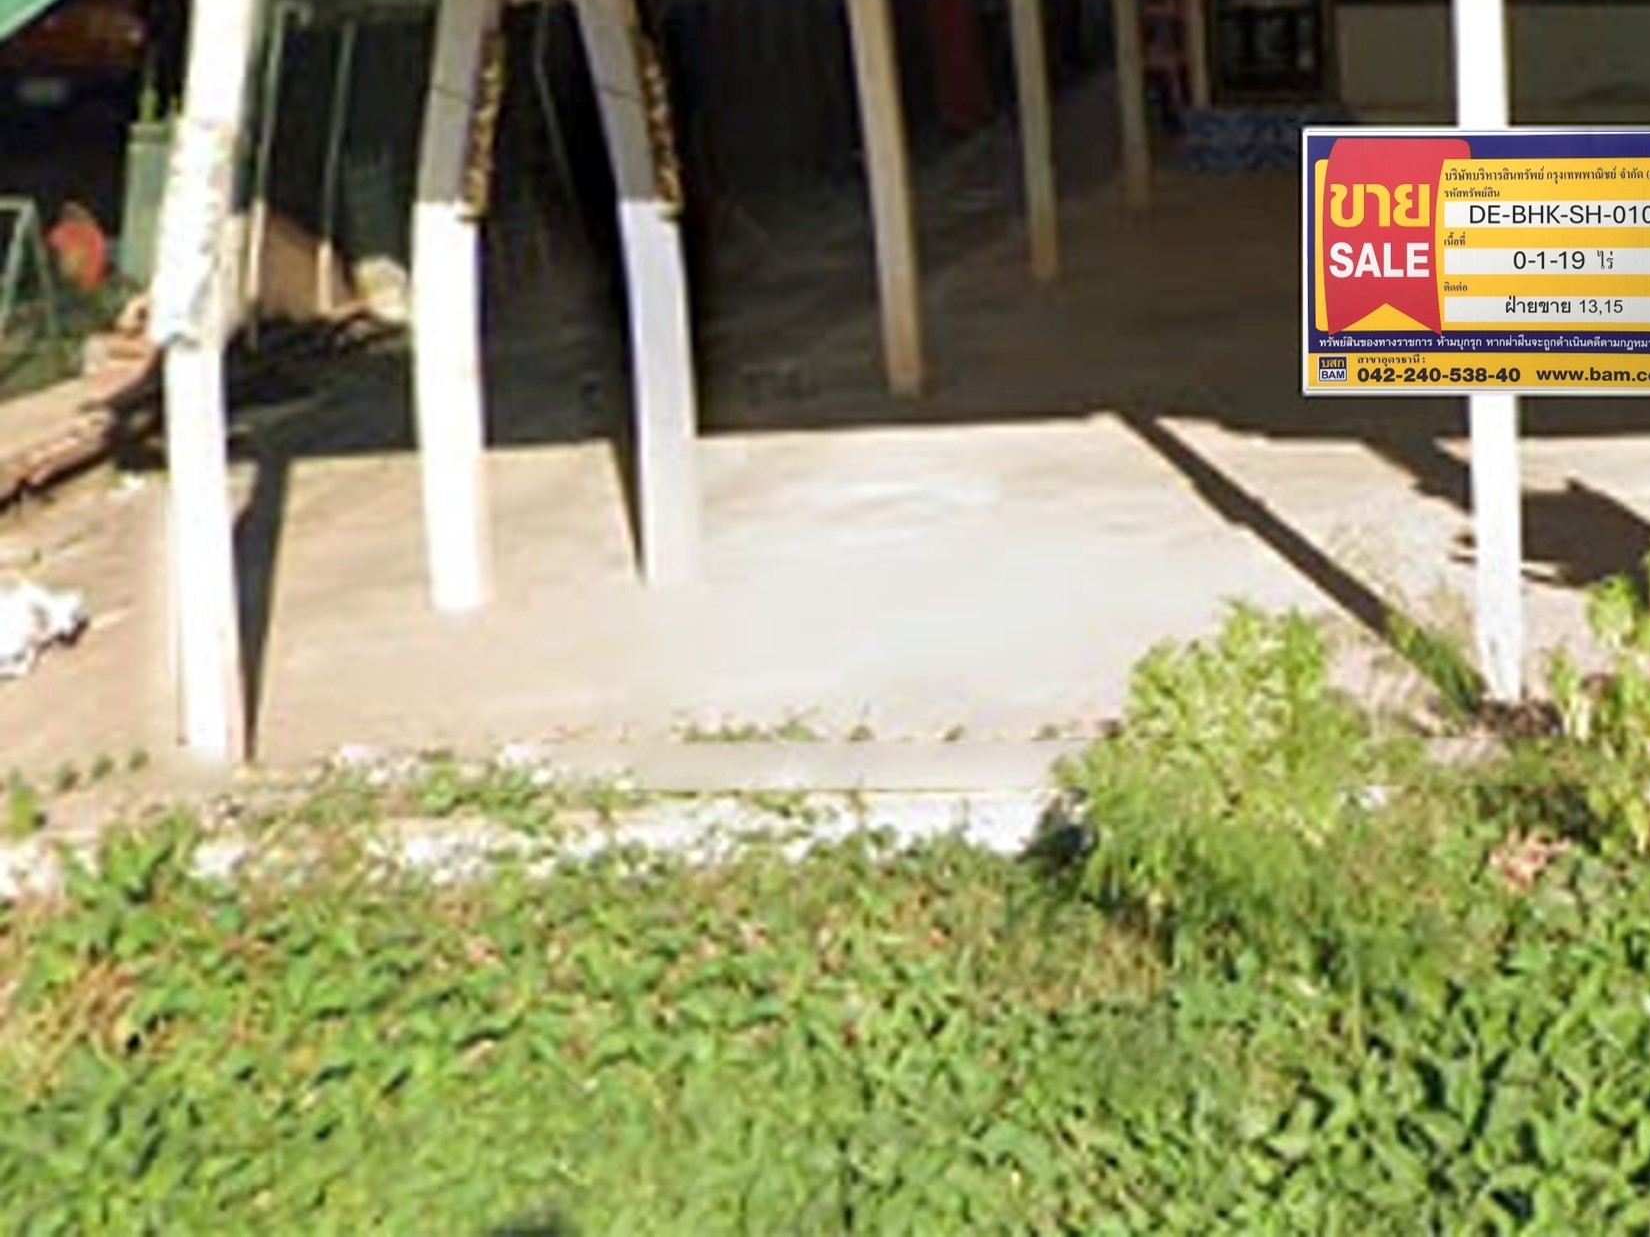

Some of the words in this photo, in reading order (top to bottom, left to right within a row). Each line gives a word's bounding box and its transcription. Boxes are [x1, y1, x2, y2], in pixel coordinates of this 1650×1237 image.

[1445, 167, 1544, 181] บริษัทบริหารสินทรัพย์
[1546, 167, 1617, 184] กรุงเทพพาณิชย์
[1619, 167, 1645, 180] จำกัด
[1443, 187, 1500, 198] รหัสทรัพย์สิน
[1330, 183, 1431, 228] ขาย
[1444, 231, 1466, 246] เนื้อที่
[1329, 241, 1430, 279] SALE
[1513, 250, 1586, 270] 0-1-19
[1596, 249, 1614, 270] ไร่
[1443, 282, 1469, 293] ติดต่อ
[1505, 295, 1571, 314] ฝ่ายขาย
[1579, 299, 1624, 316] 13,15
[1319, 336, 1433, 347] ทรัพย์สินของทางราชการ
[1436, 335, 1482, 351] ห้ามบุกรุก
[1321, 358, 1345, 368] บสก
[1321, 370, 1345, 380] BAM
[1357, 365, 1521, 383] 042-240-538-40
